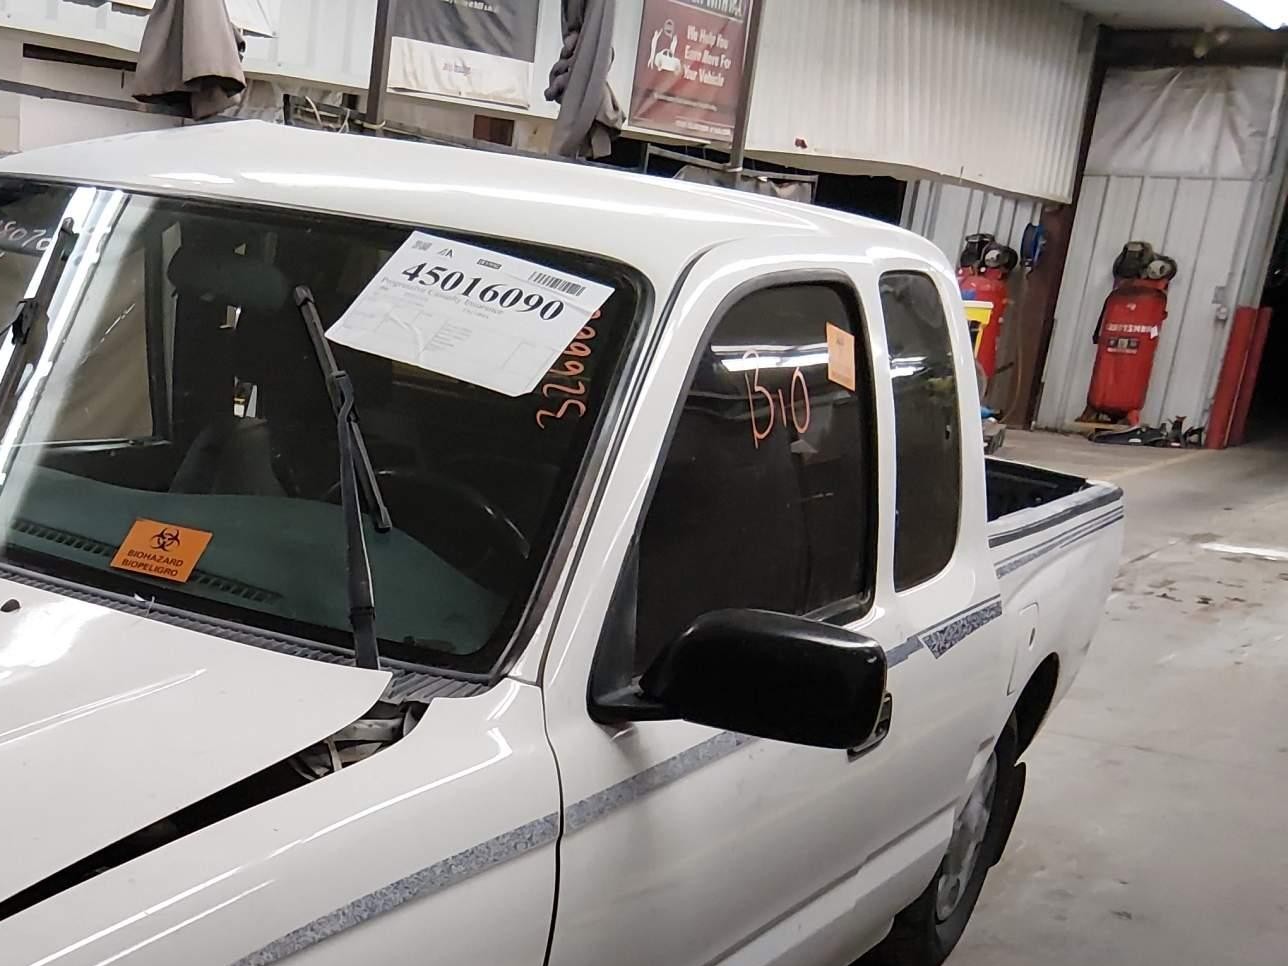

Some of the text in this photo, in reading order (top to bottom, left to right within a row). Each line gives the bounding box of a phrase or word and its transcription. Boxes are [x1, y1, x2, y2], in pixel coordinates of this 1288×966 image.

[401, 262, 566, 321] 45016090
[121, 558, 178, 577] BIOPELIGRO
[127, 549, 184, 567] BIOHAZARD
